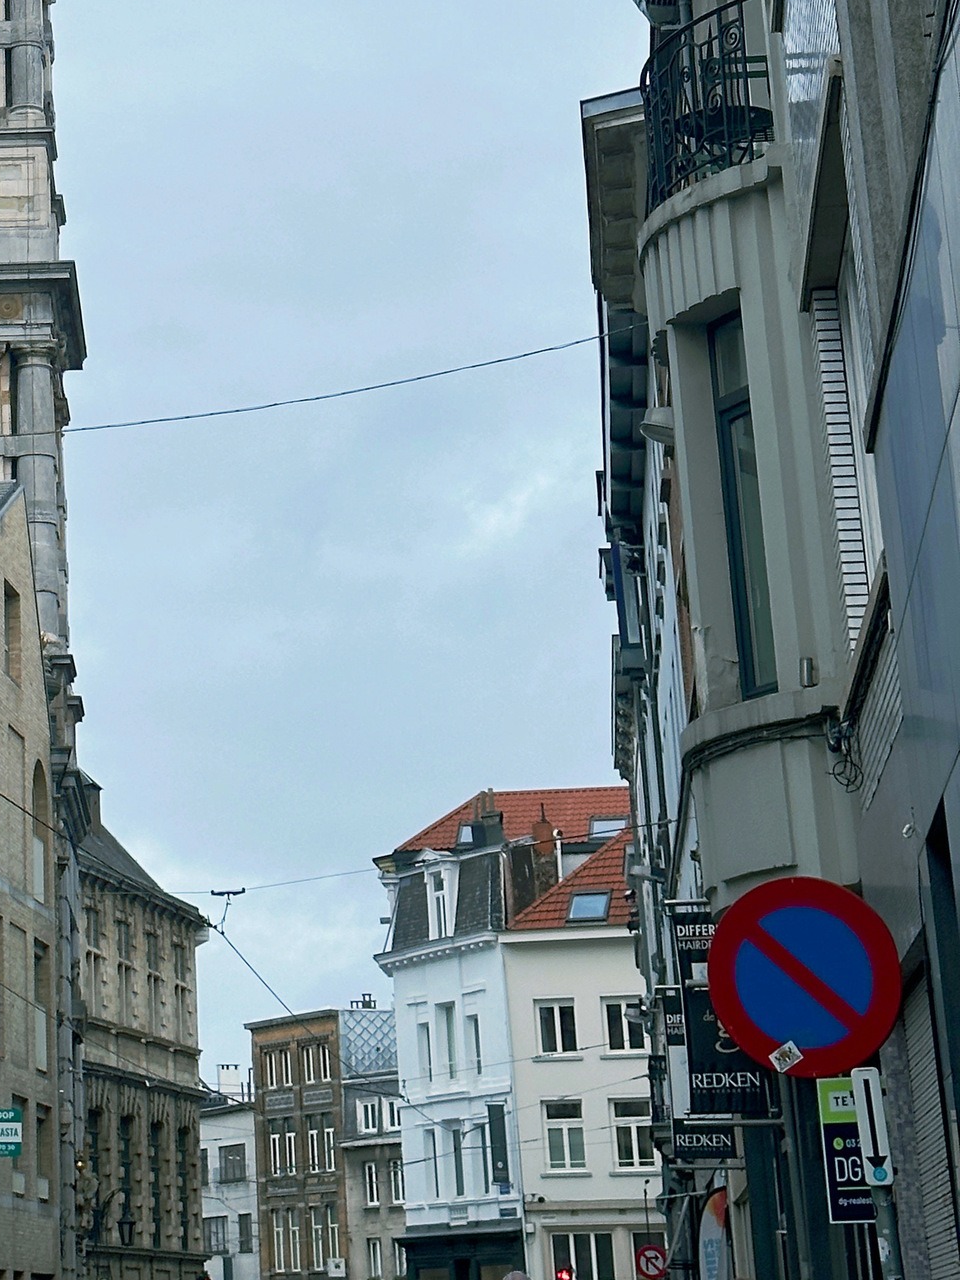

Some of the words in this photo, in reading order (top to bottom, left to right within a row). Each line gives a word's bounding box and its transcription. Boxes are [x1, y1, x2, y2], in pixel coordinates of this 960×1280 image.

[676, 924, 719, 937] DIFFER
[691, 1071, 760, 1088] REDKEN
[675, 1133, 732, 1147] REDKEN
